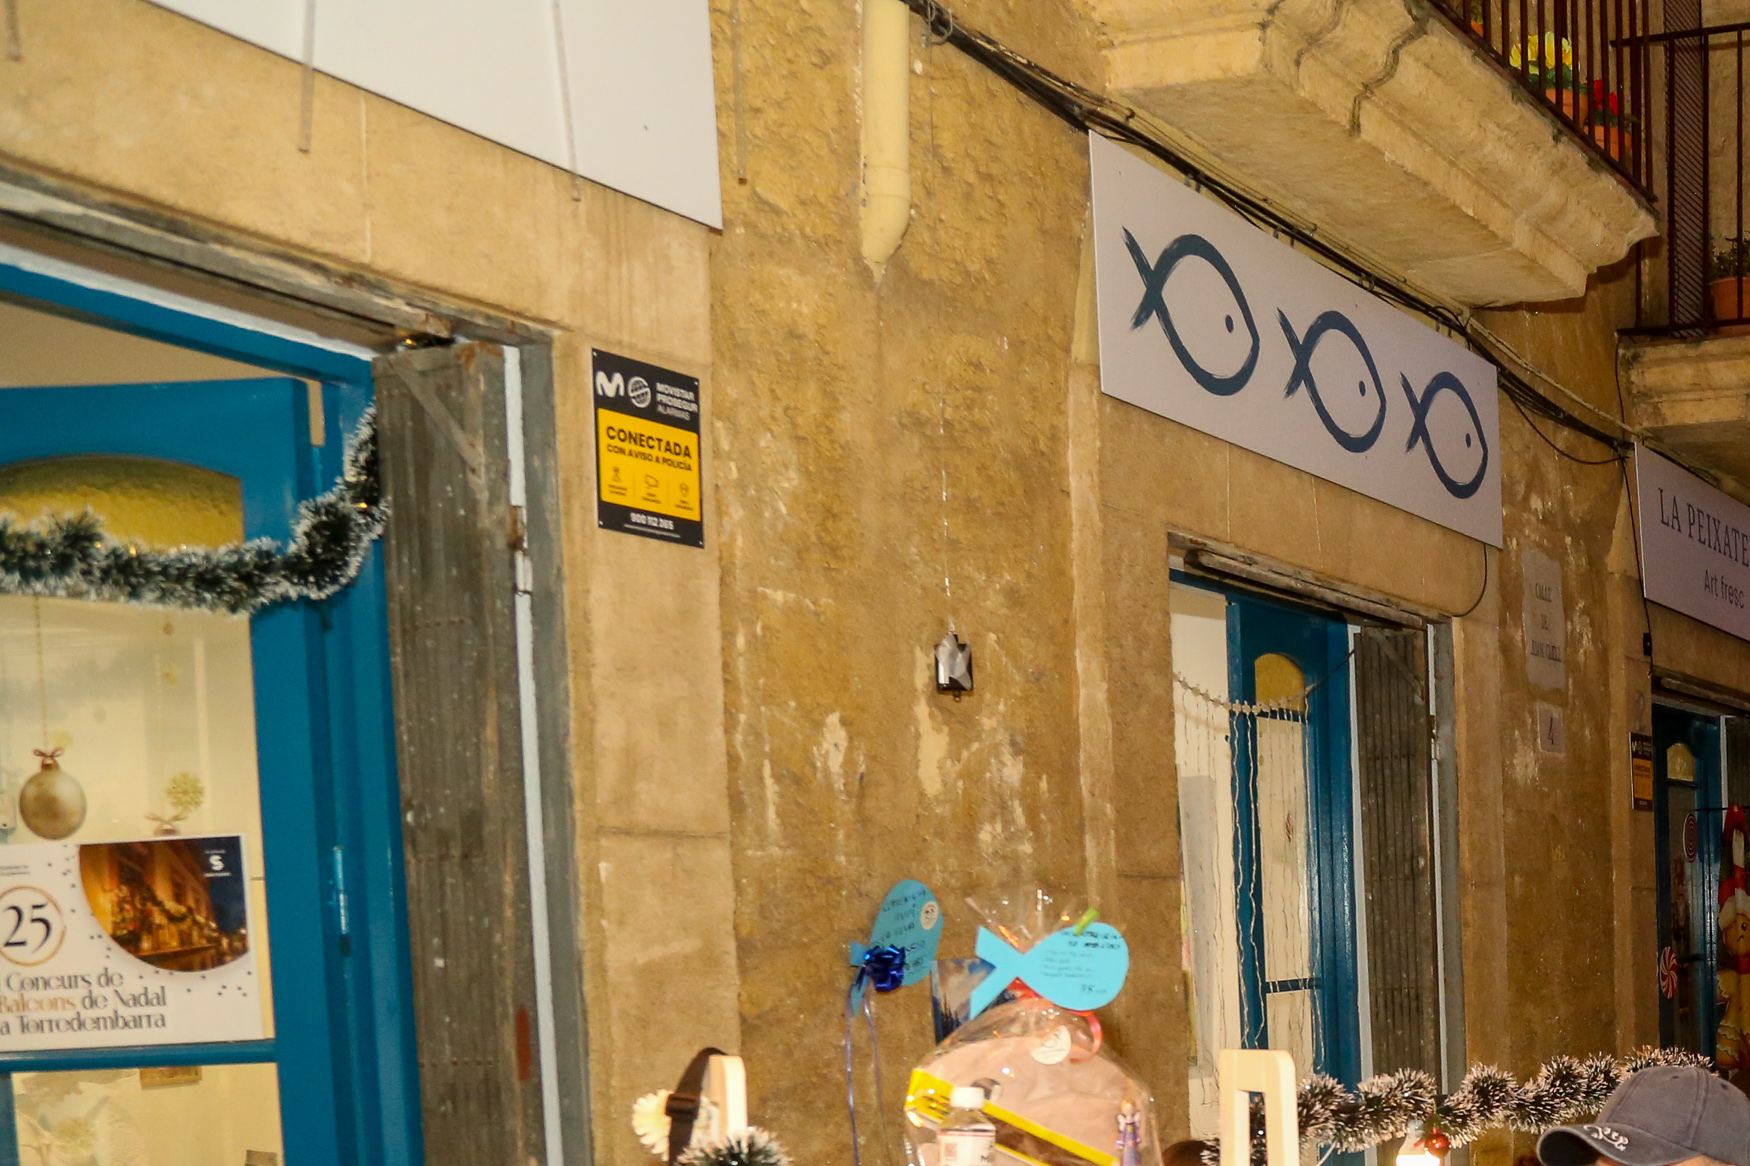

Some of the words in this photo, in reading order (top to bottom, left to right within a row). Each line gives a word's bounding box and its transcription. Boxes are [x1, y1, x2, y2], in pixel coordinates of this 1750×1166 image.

[655, 382, 695, 402] MOVISTAR
[655, 392, 698, 413] PROSEGUR
[656, 403, 691, 421] ALARMAS
[606, 425, 693, 460] CONECTADA
[606, 443, 627, 457] CON
[627, 449, 654, 463] AVISO
[655, 455, 662, 465] A
[662, 456, 694, 472] POLICÍA
[1657, 486, 1682, 534] LA
[1703, 568, 1719, 599] Art
[1720, 574, 1745, 610] fresc
[3, 903, 52, 954] 25
[6, 971, 92, 993] Concurs
[97, 966, 124, 988] de
[82, 985, 109, 1010] de
[112, 984, 167, 1009] Nadal
[0, 1019, 11, 1035] a
[17, 1011, 167, 1034] Torredembarra
